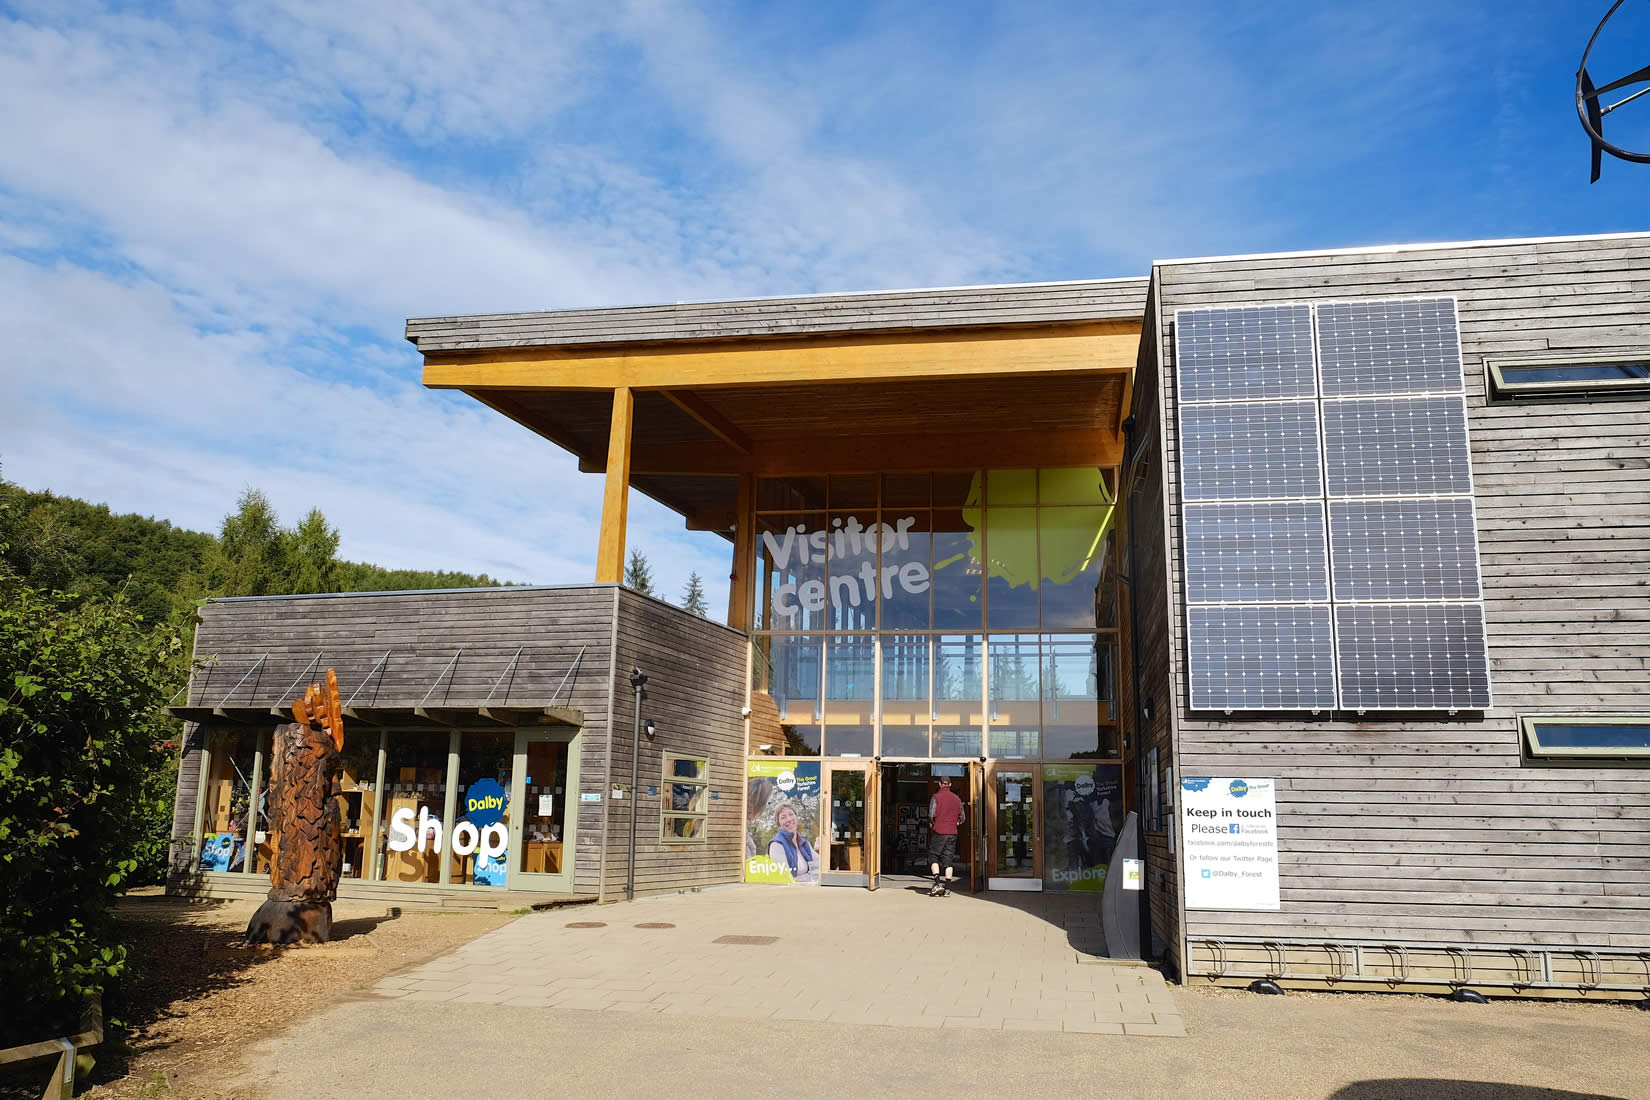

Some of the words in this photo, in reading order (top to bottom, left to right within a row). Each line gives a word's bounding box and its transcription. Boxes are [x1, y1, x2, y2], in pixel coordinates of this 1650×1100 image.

[763, 516, 916, 569] Visitor
[773, 561, 930, 616] centre
[468, 795, 504, 812] Dalby
[1186, 808, 1217, 819] Keep
[1221, 808, 1233, 818] in
[1236, 808, 1272, 818] touch
[389, 805, 508, 869] Shop
[1191, 823, 1228, 834] Please
[1052, 866, 1106, 885] Explore
